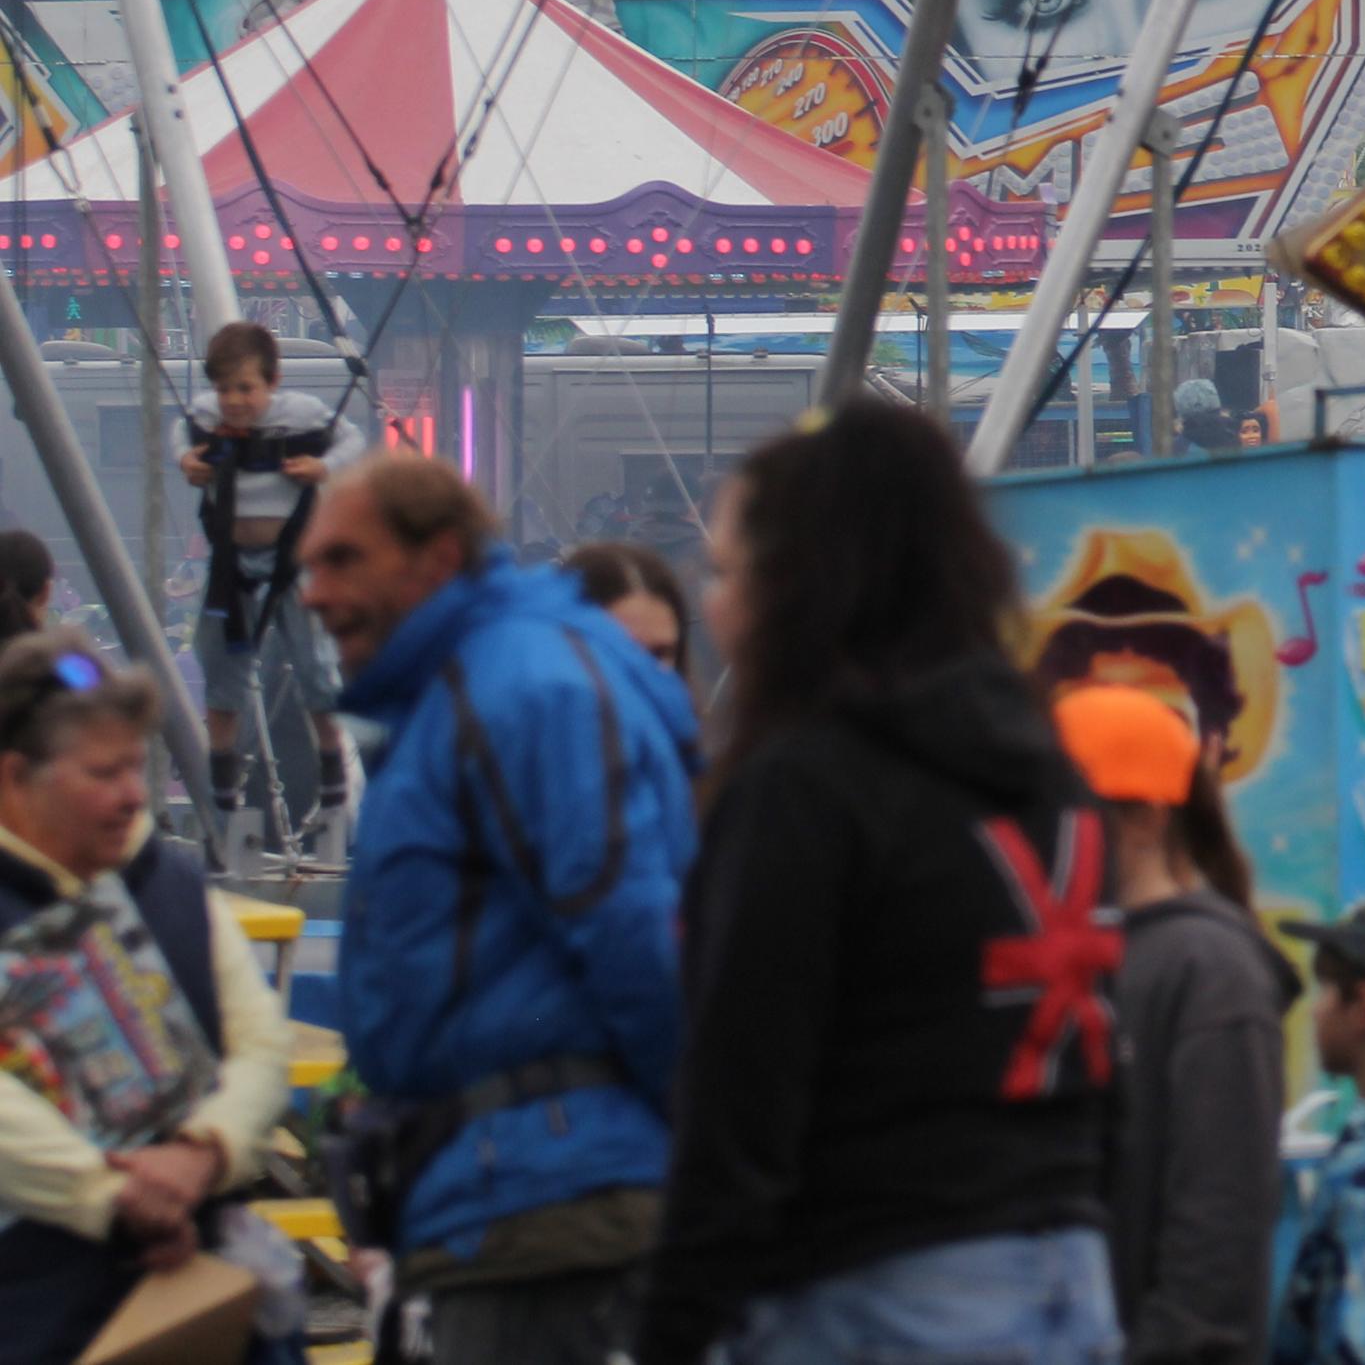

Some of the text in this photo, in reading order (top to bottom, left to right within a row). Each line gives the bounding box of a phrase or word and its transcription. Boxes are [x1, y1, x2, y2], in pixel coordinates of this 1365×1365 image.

[760, 58, 784, 88] 210
[776, 62, 805, 97] 240
[793, 81, 827, 119] 270
[812, 111, 849, 148] 300
[1237, 243, 1262, 253] 202
